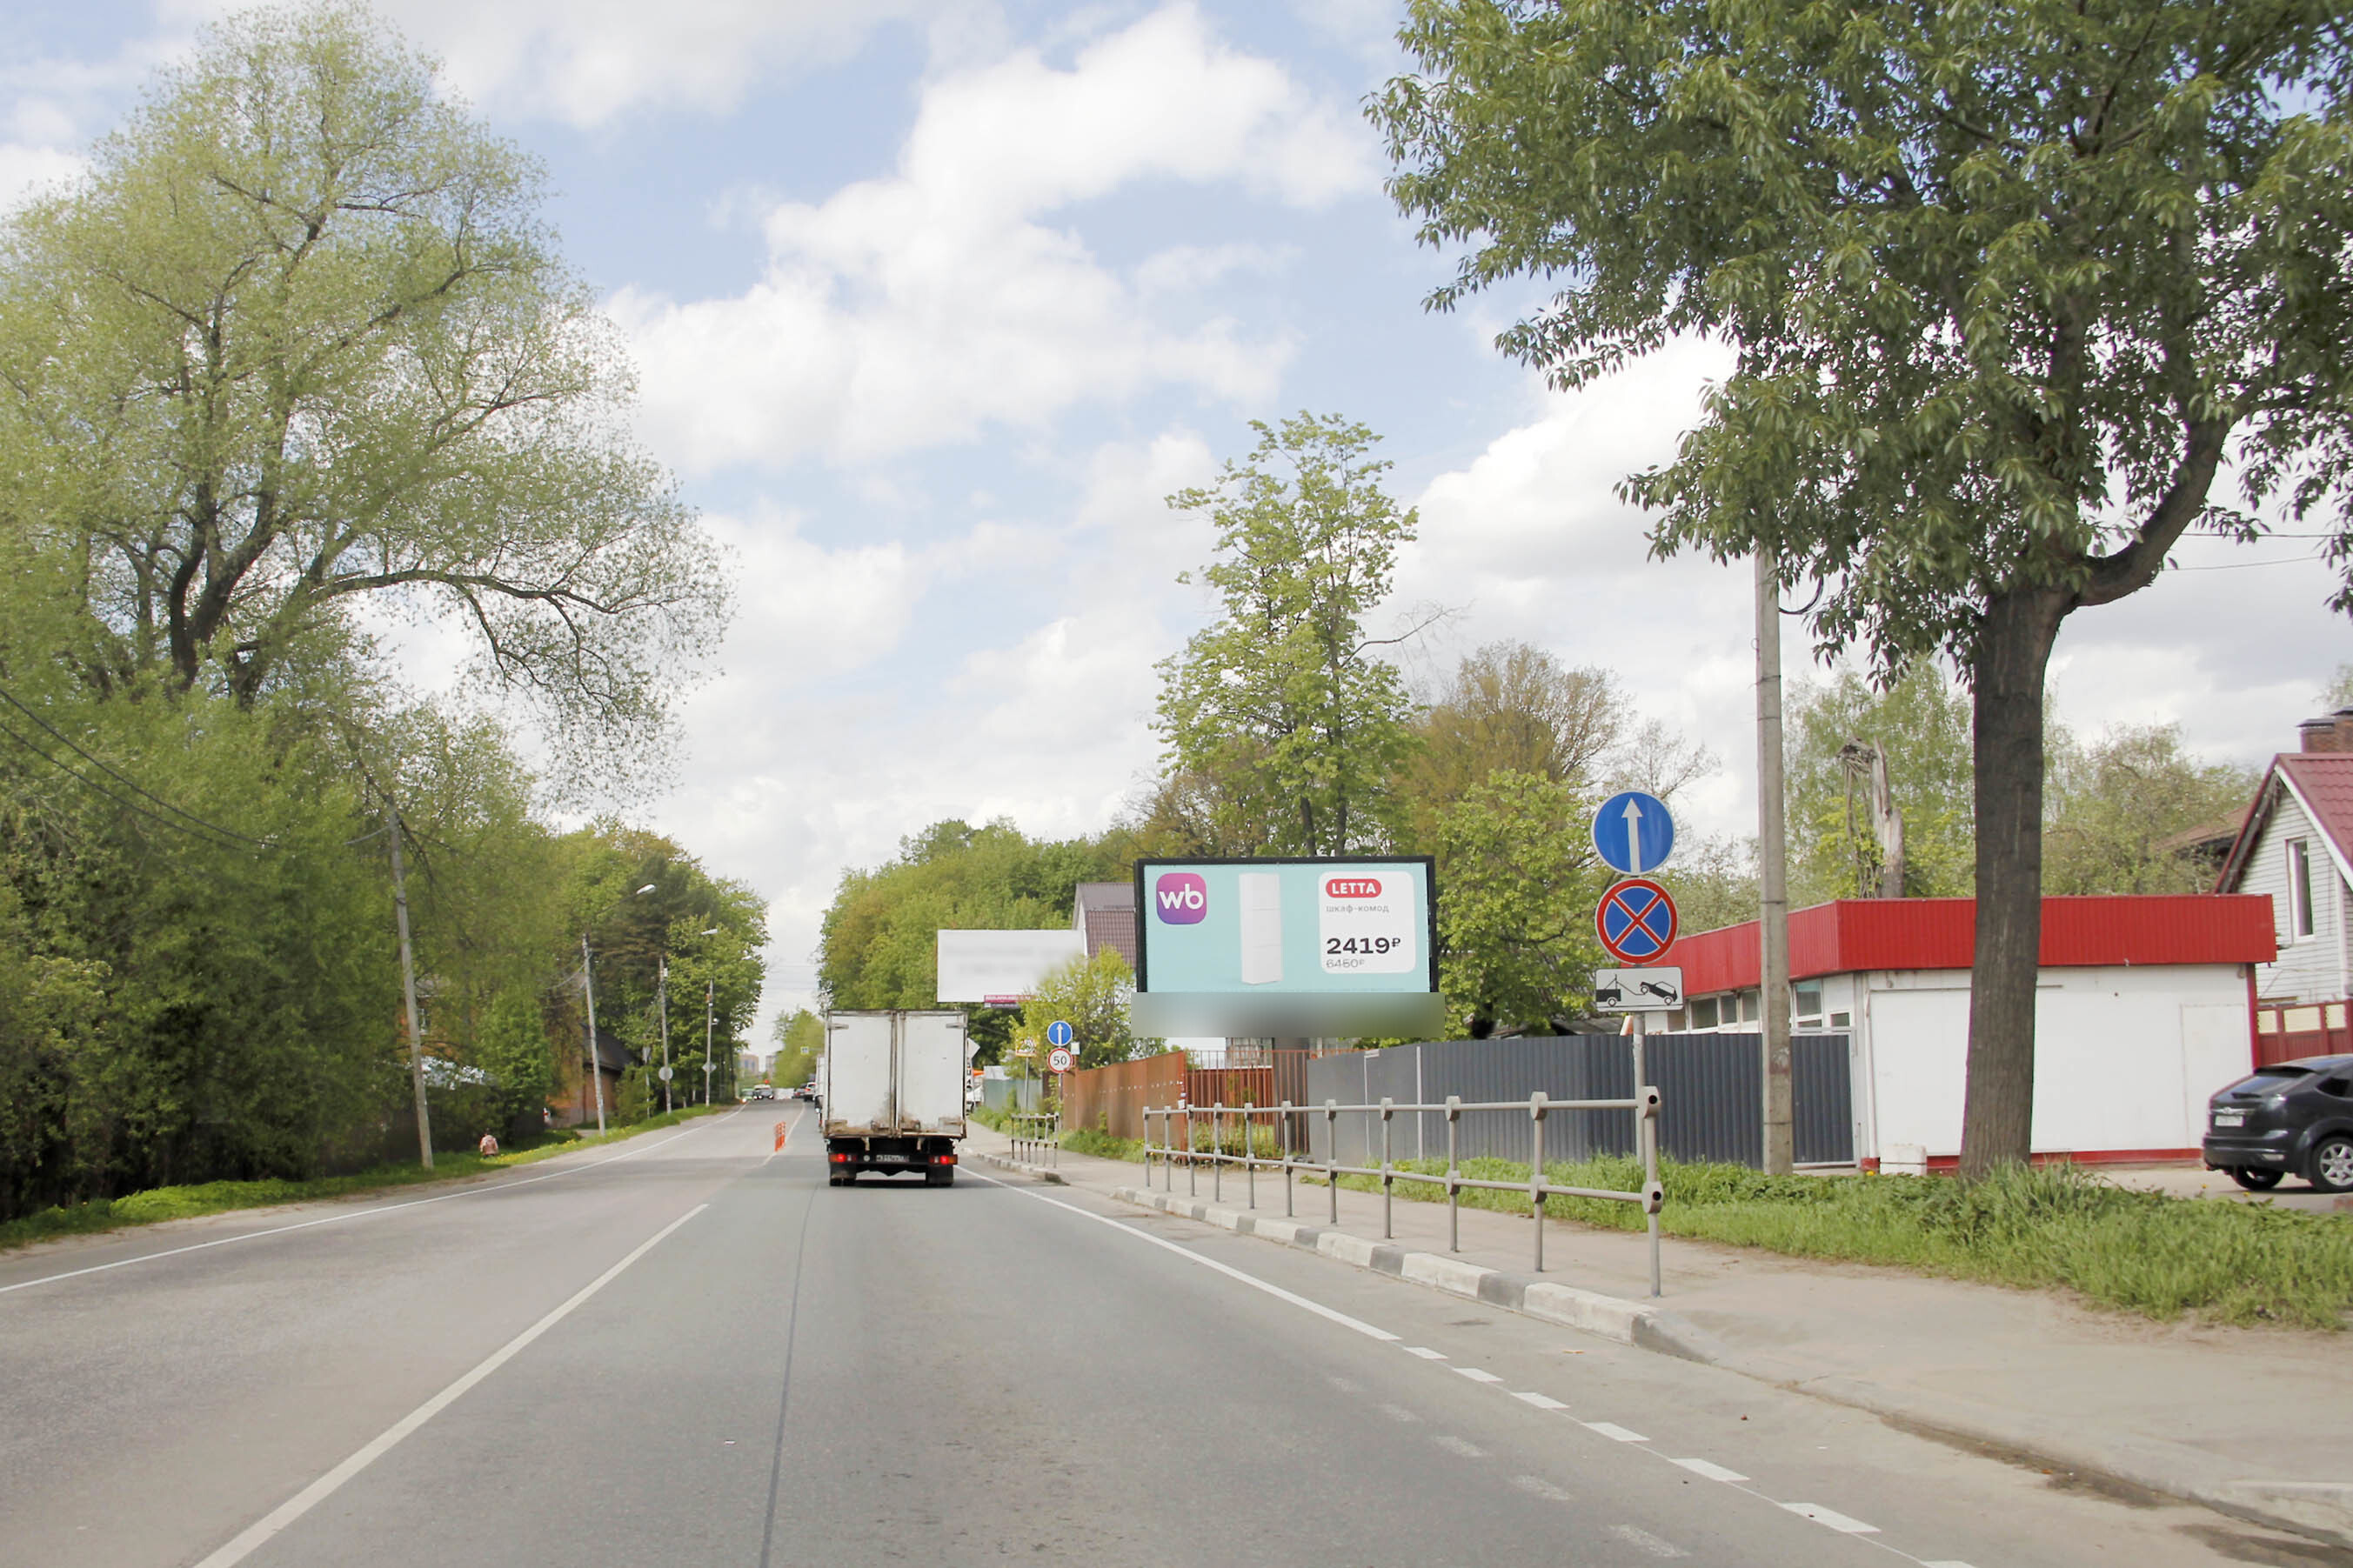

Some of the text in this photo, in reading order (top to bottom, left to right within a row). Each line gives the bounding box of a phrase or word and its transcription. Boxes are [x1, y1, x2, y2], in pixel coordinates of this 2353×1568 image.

[1332, 882, 1377, 895] LETTA
[1159, 883, 1204, 910] wb
[1326, 904, 1390, 914] шкаф-комод
[1053, 1055, 1068, 1066] 50
